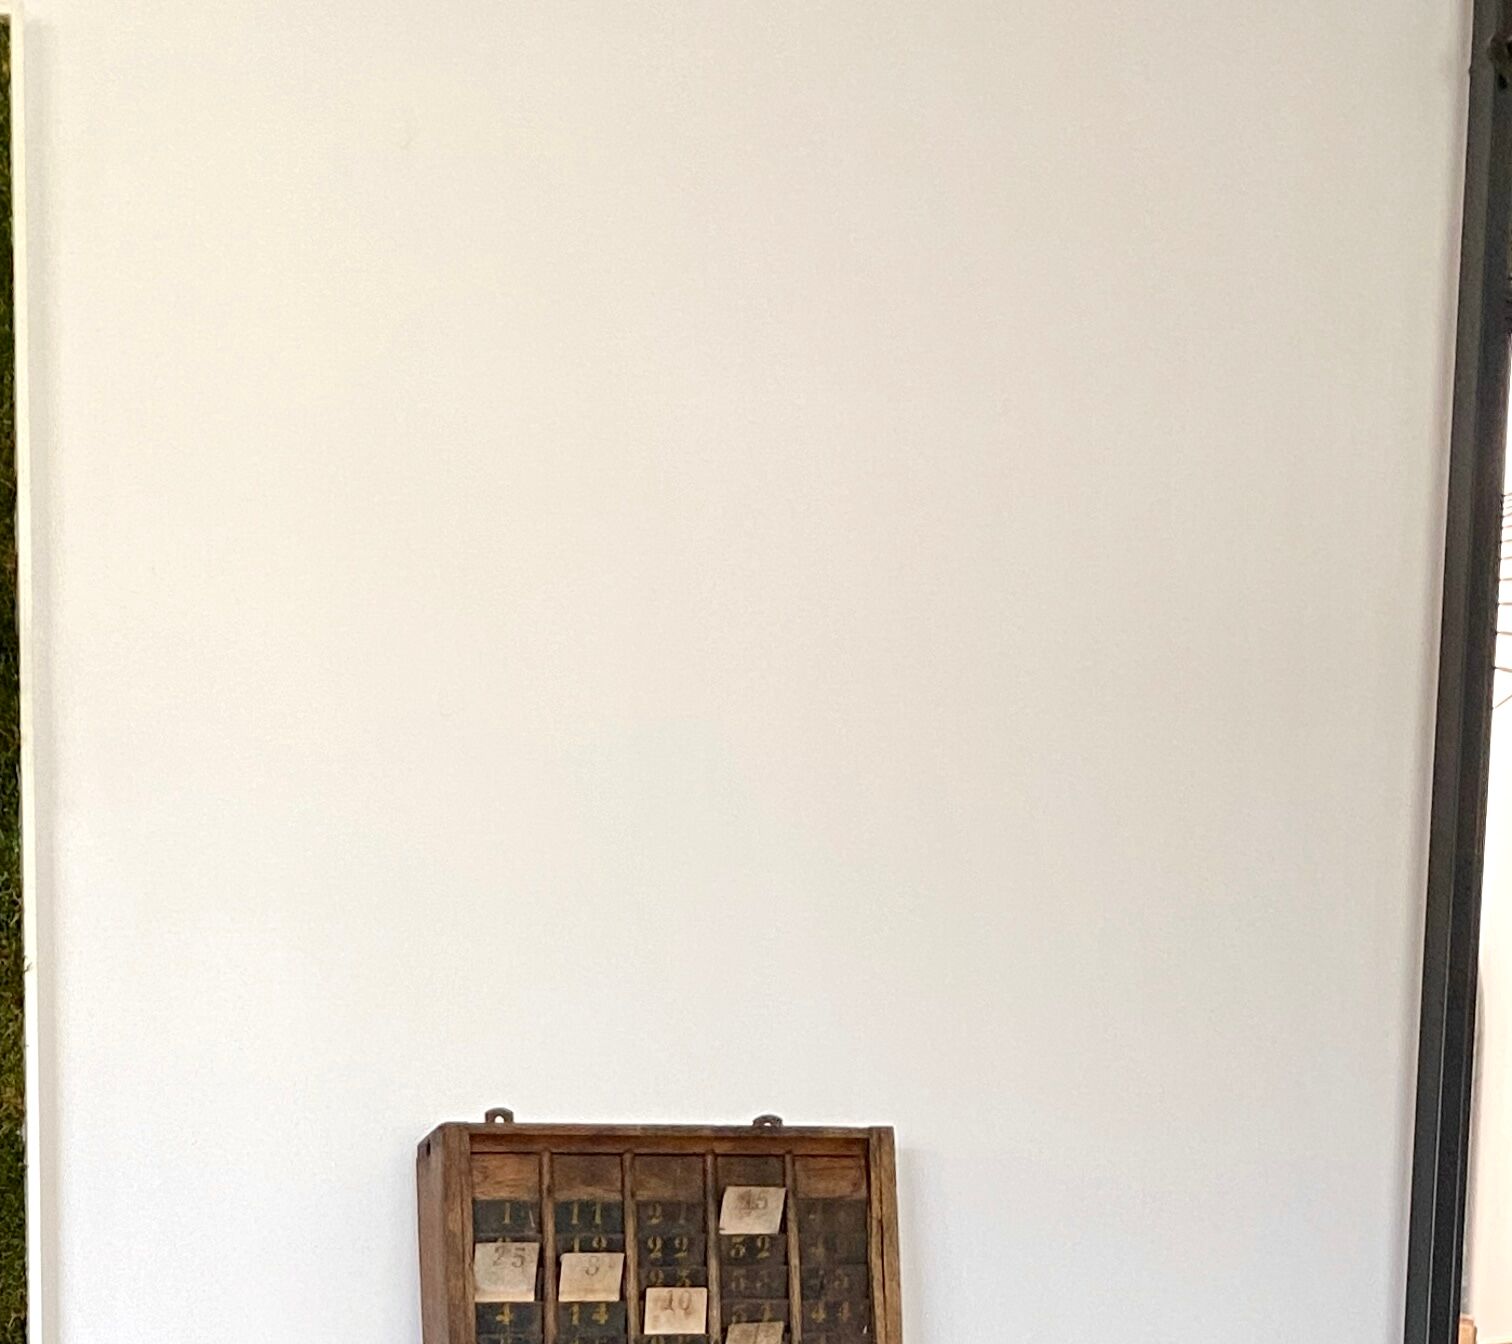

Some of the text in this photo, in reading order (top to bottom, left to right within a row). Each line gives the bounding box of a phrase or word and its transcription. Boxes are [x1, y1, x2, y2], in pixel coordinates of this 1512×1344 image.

[502, 1202, 512, 1225] 1
[570, 1201, 602, 1225] 11
[492, 1245, 526, 1269] 25
[647, 1235, 689, 1259] 22
[495, 1303, 514, 1326] 4
[570, 1303, 609, 1326] 14
